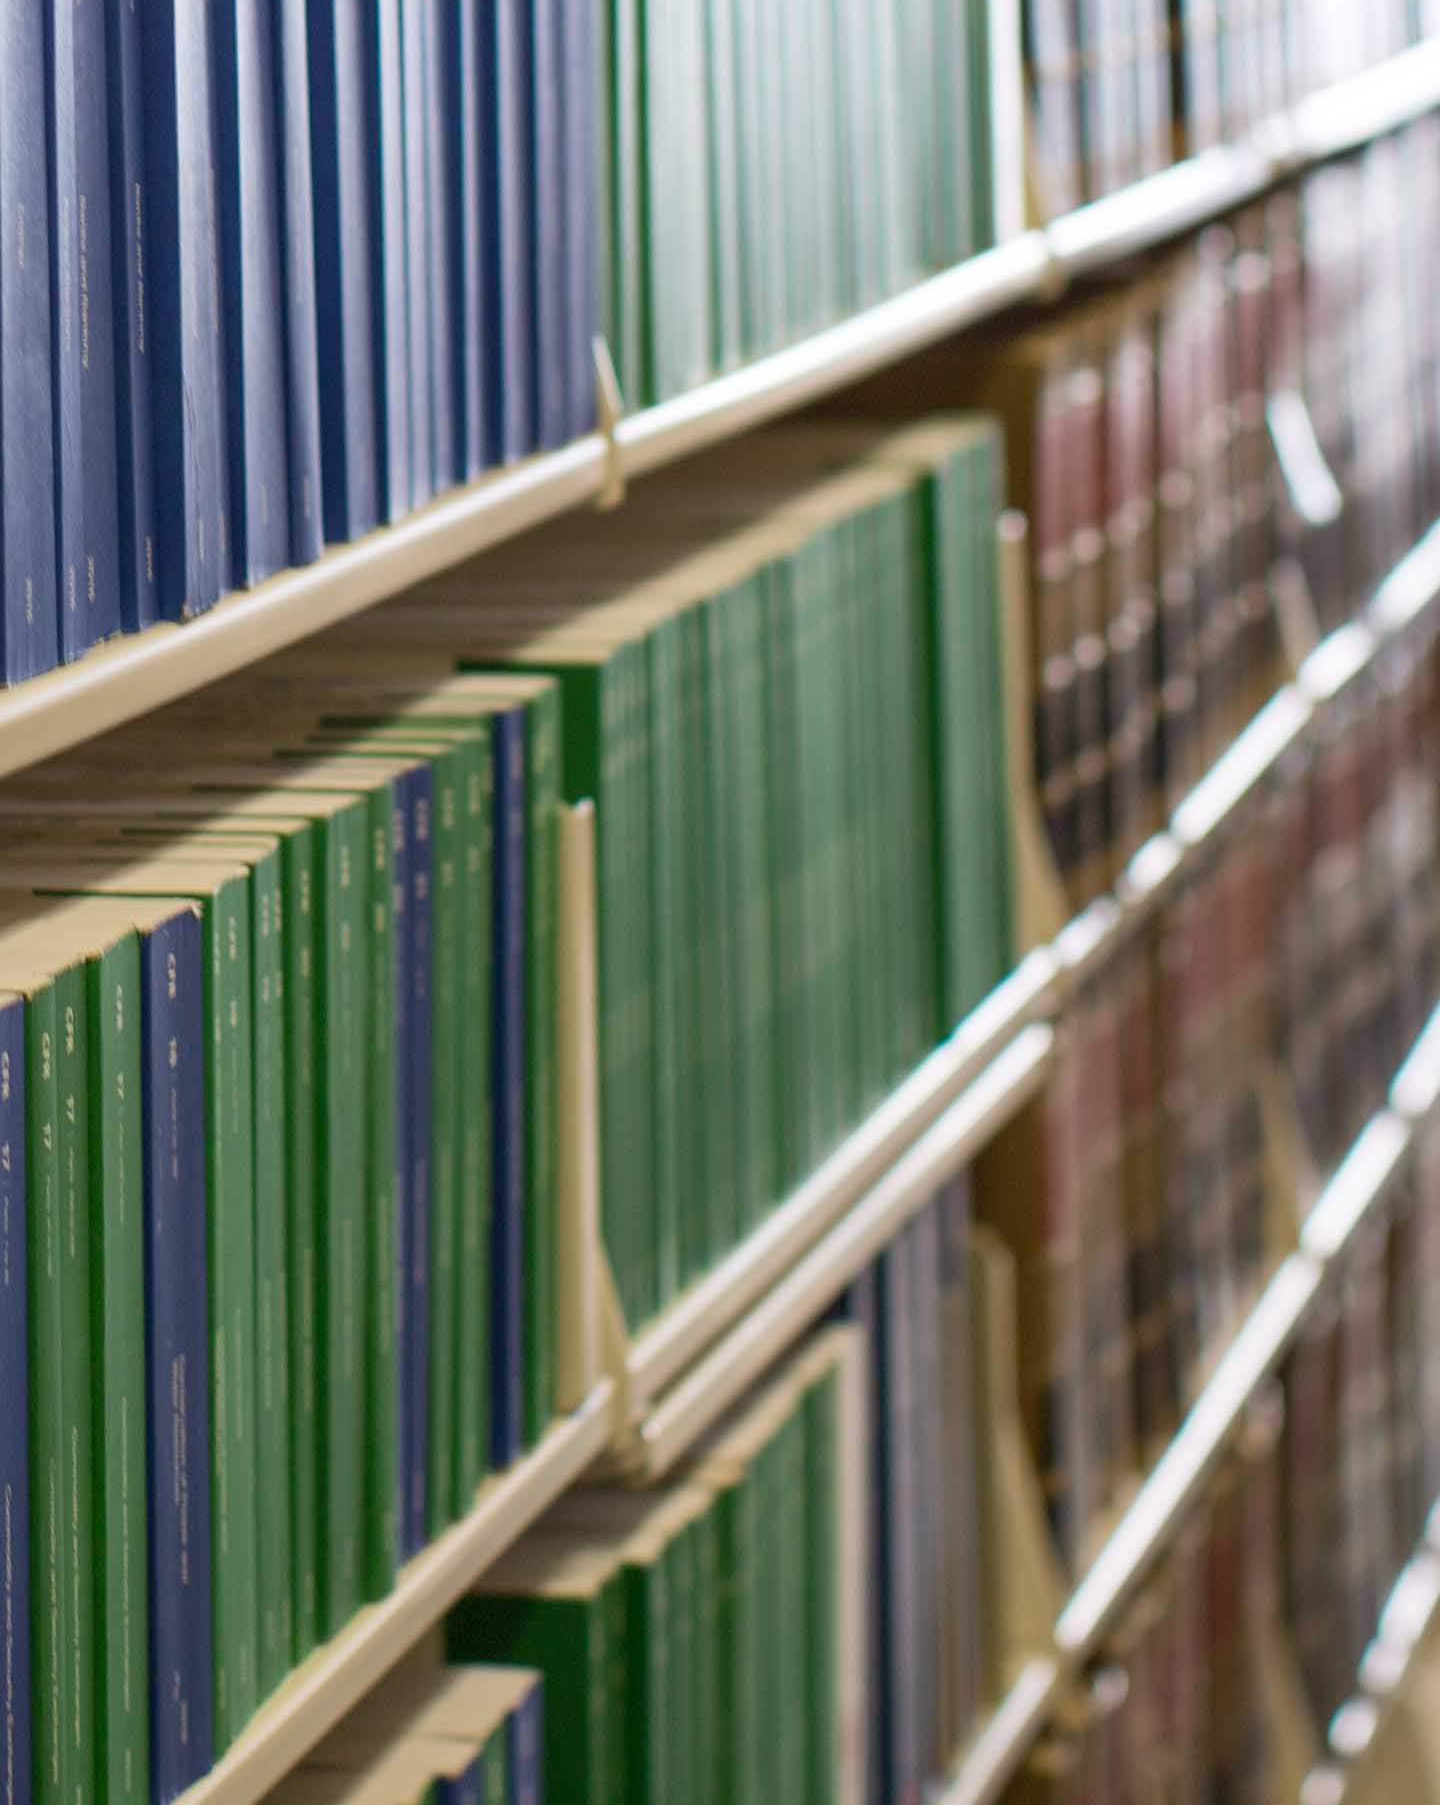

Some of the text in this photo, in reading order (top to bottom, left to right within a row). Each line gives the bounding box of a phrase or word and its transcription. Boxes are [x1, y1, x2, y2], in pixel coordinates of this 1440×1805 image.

[166, 951, 177, 1001] CFR
[41, 1031, 52, 1151] CFR 17
[64, 1005, 76, 1124] CFR 17
[115, 984, 125, 1100] CFR 17
[0, 1050, 12, 1172] CFR 17
